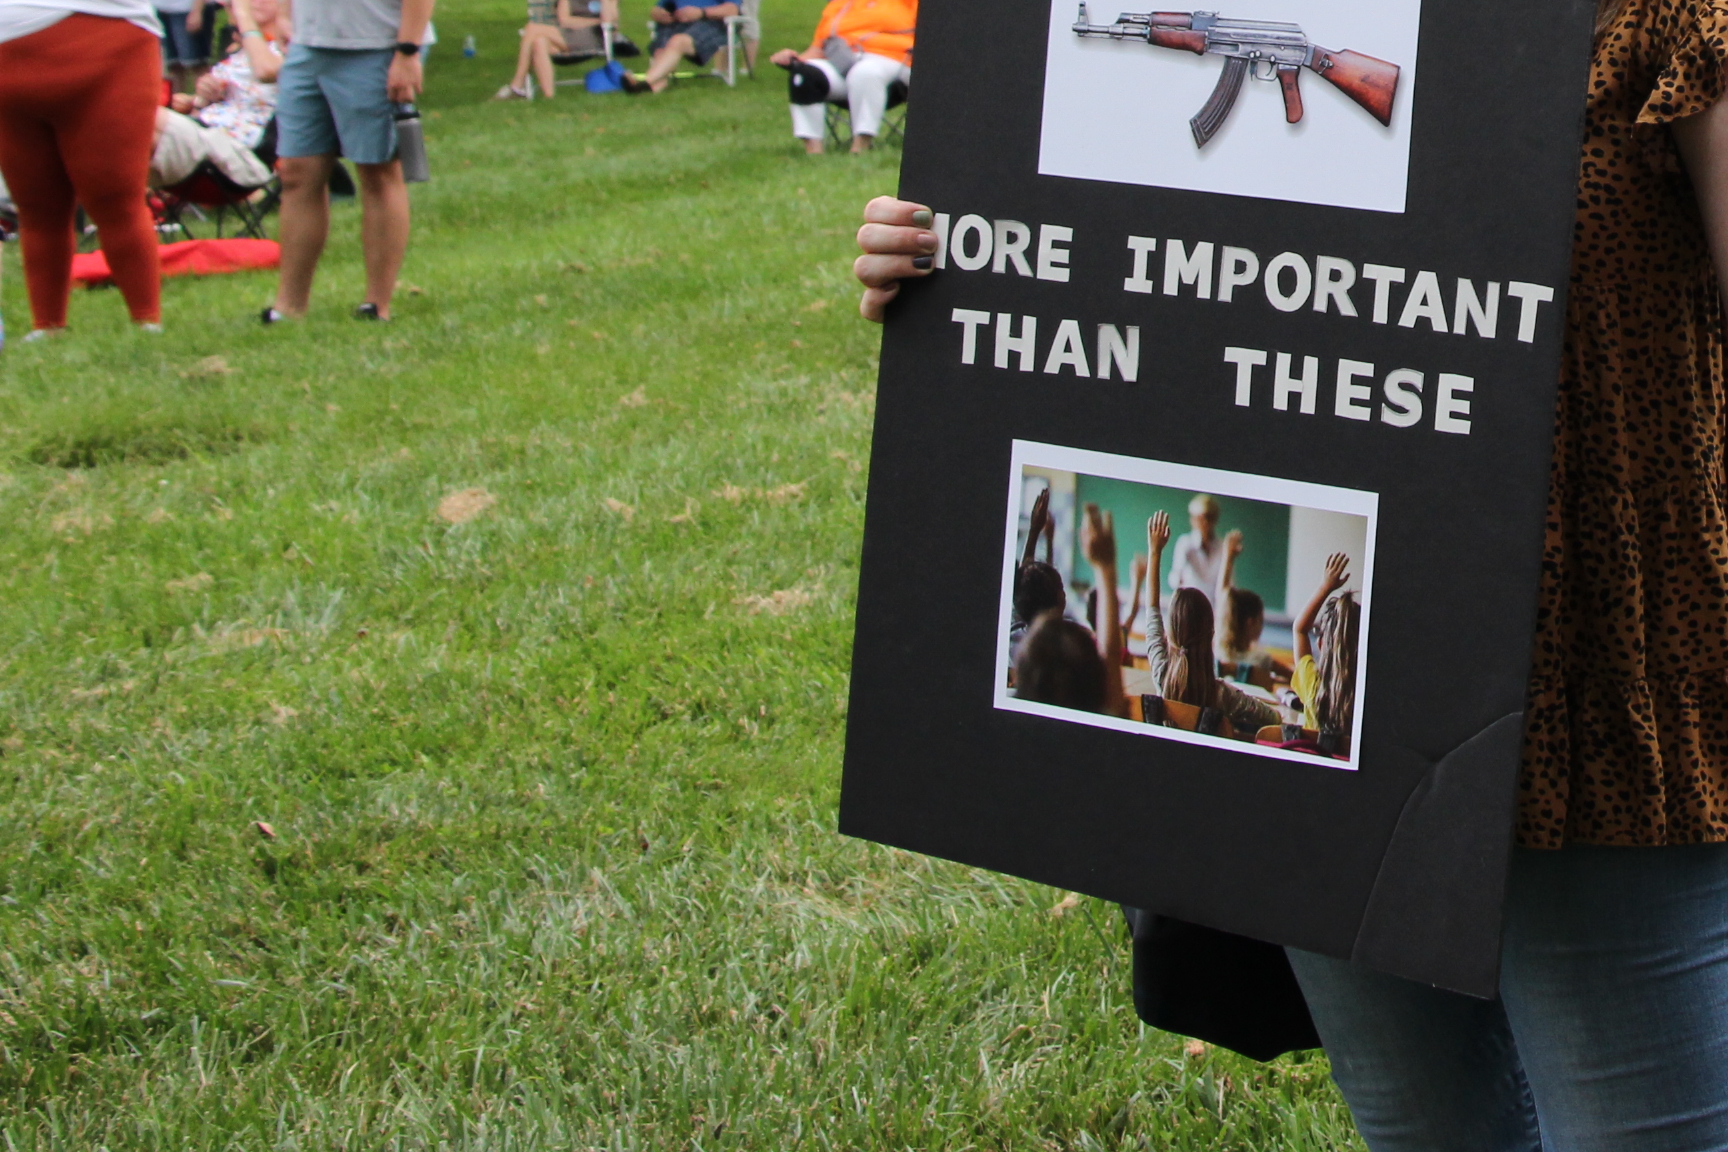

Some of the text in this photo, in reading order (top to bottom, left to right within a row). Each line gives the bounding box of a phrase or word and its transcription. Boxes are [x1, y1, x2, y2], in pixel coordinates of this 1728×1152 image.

[1124, 236, 1554, 341] IMPORTANT
[952, 308, 1474, 434] THAN THESE
